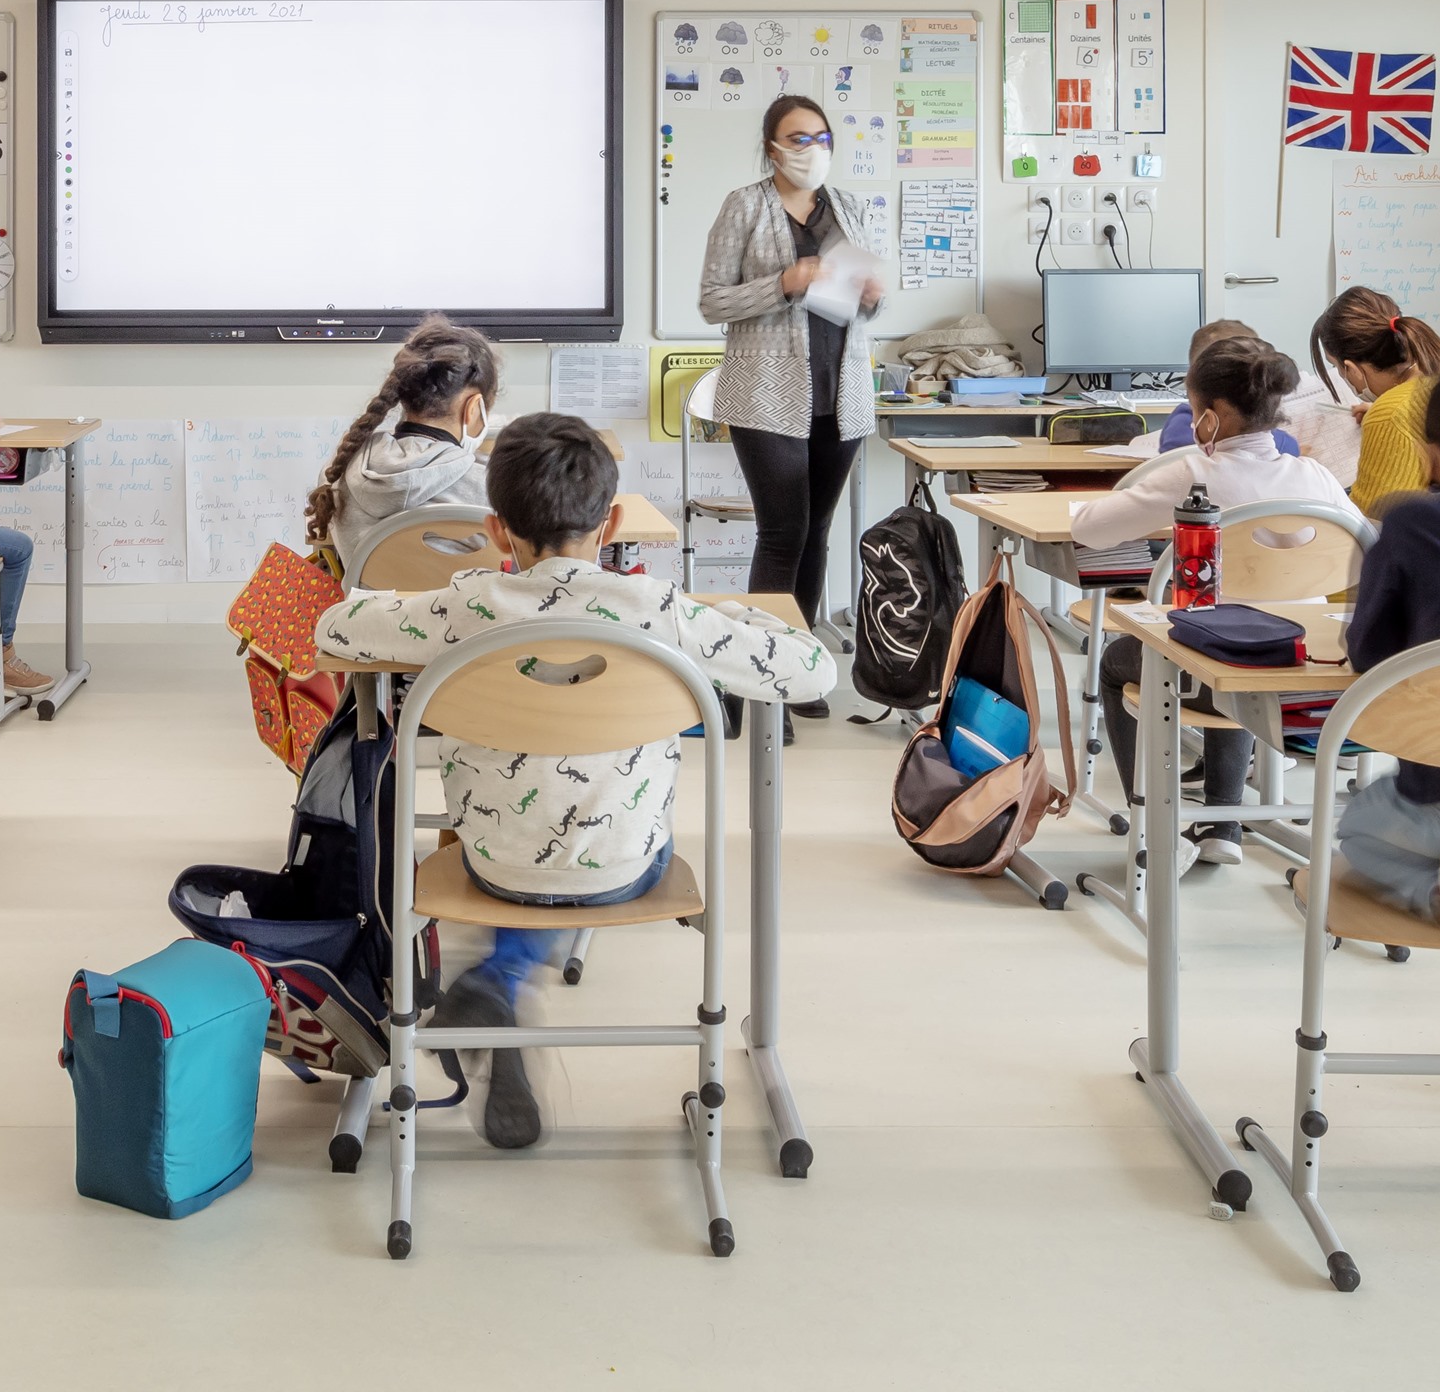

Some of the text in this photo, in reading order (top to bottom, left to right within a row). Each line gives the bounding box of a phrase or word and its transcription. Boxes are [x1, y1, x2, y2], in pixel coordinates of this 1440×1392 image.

[1009, 12, 1015, 20] C
[100, 1, 305, 47] Jeudi 28 janvier 2021
[1010, 36, 1046, 44] Centaines
[1070, 35, 1101, 43] Dizaines
[1128, 34, 1152, 43] Unités
[1083, 50, 1093, 64] 6
[1138, 51, 1148, 65] 5
[921, 89, 946, 97] DICTÉE
[855, 150, 873, 160] It is
[853, 164, 875, 175] (It's)
[1080, 161, 1092, 170] 60
[1354, 164, 1378, 183] Art
[107, 428, 176, 442] dans mon
[111, 451, 126, 466] la
[640, 461, 674, 480] Nadia
[163, 477, 171, 490] 5
[96, 516, 127, 528] cartes
[152, 509, 167, 527] la
[137, 554, 146, 567] 4
[158, 555, 184, 569] cartes
